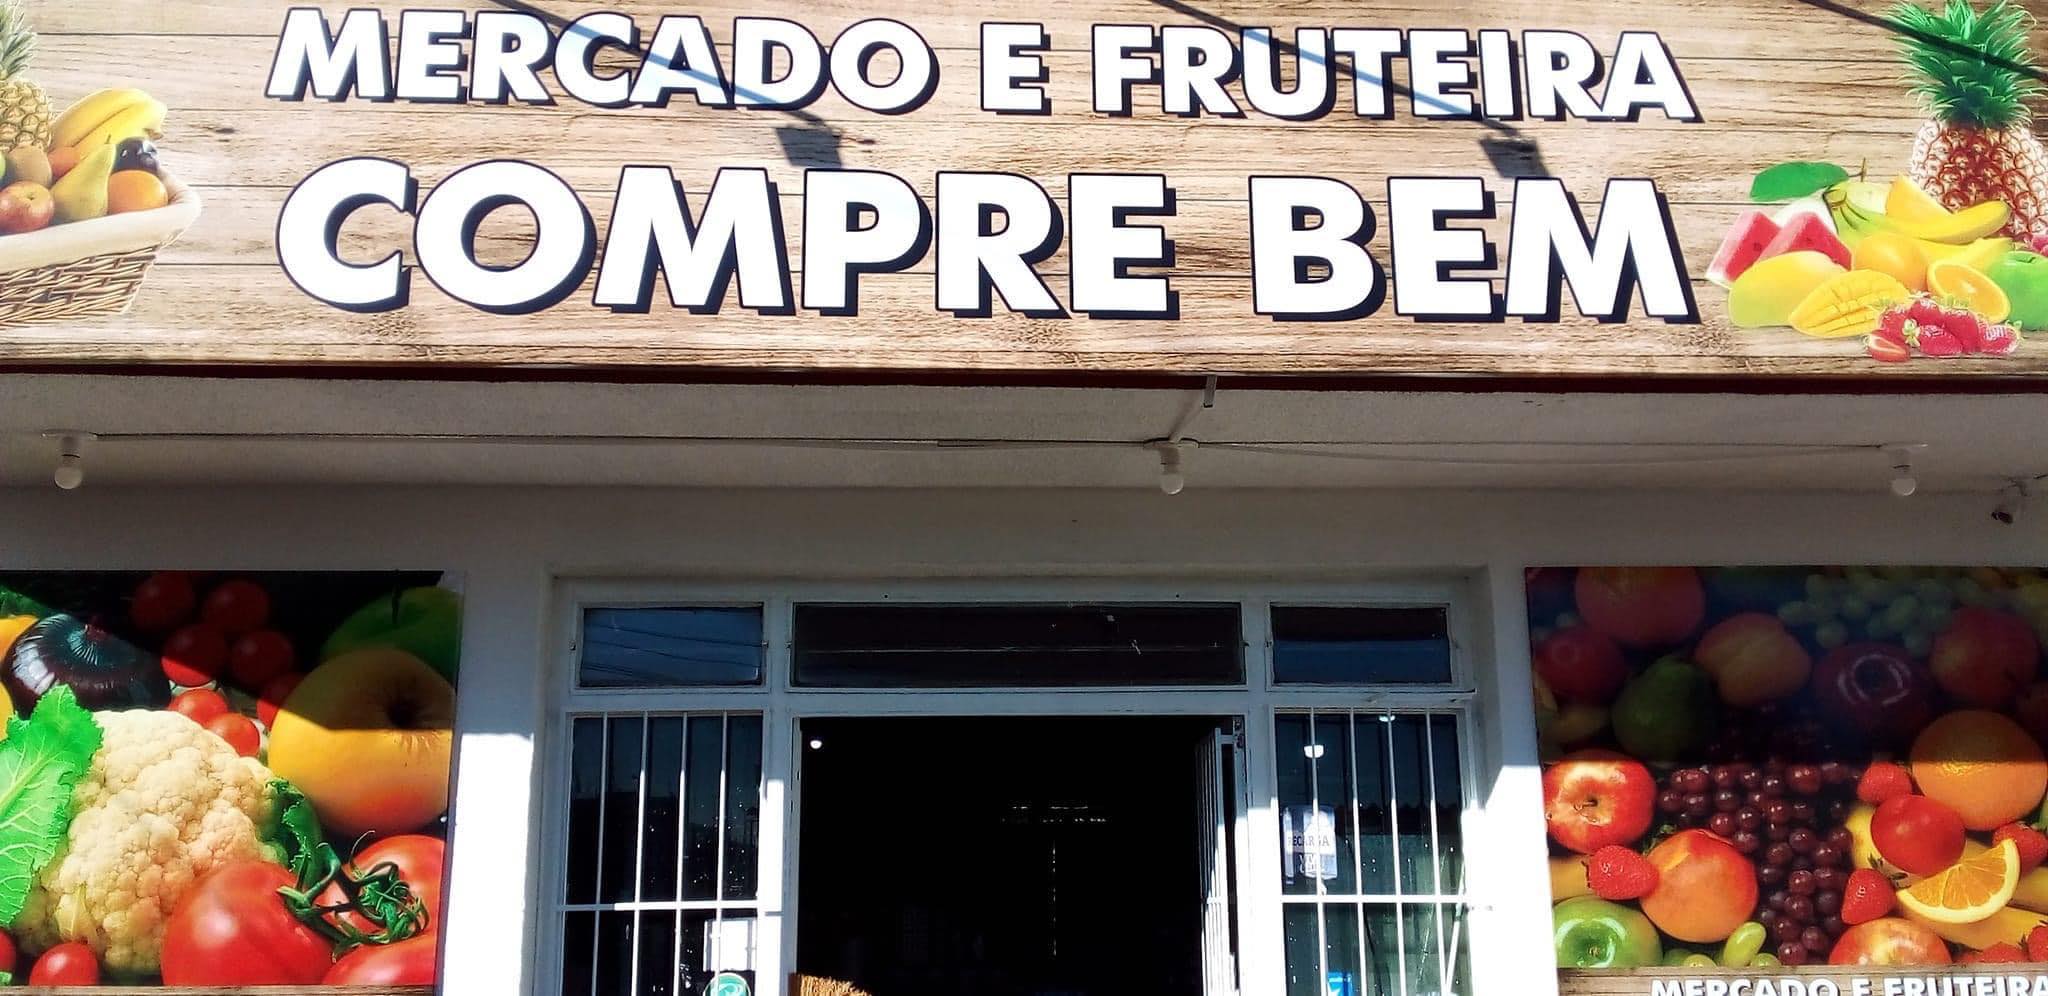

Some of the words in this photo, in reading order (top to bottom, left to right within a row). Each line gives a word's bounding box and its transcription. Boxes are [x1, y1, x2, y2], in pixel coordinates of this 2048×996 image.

[265, 7, 939, 114] MERCADO
[980, 22, 1051, 115] E
[1091, 23, 1705, 123] FRUTEIRA
[276, 156, 1181, 320] COMPRE
[1248, 176, 1701, 324] BEM
[1651, 977, 1840, 996] MERCADO
